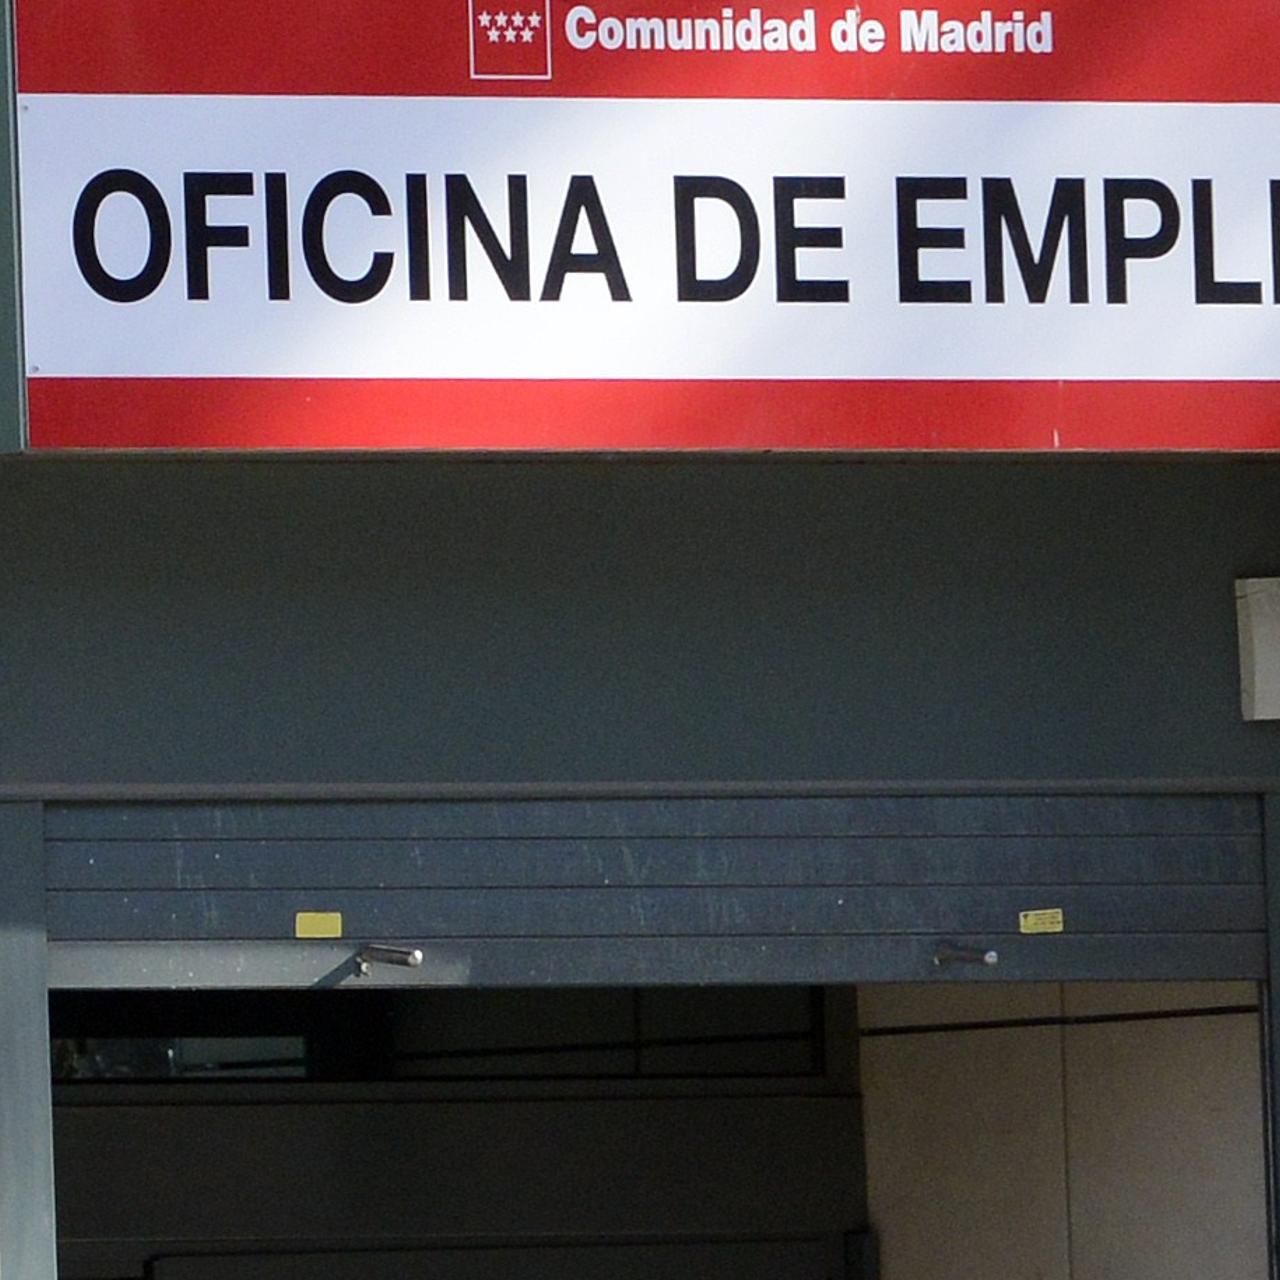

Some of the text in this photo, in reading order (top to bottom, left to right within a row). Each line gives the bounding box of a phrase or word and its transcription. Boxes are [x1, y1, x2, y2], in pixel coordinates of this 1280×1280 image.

[563, 4, 1054, 54] Comunidad de Madrid
[72, 168, 633, 304] OFICINA
[676, 175, 852, 304] DE
